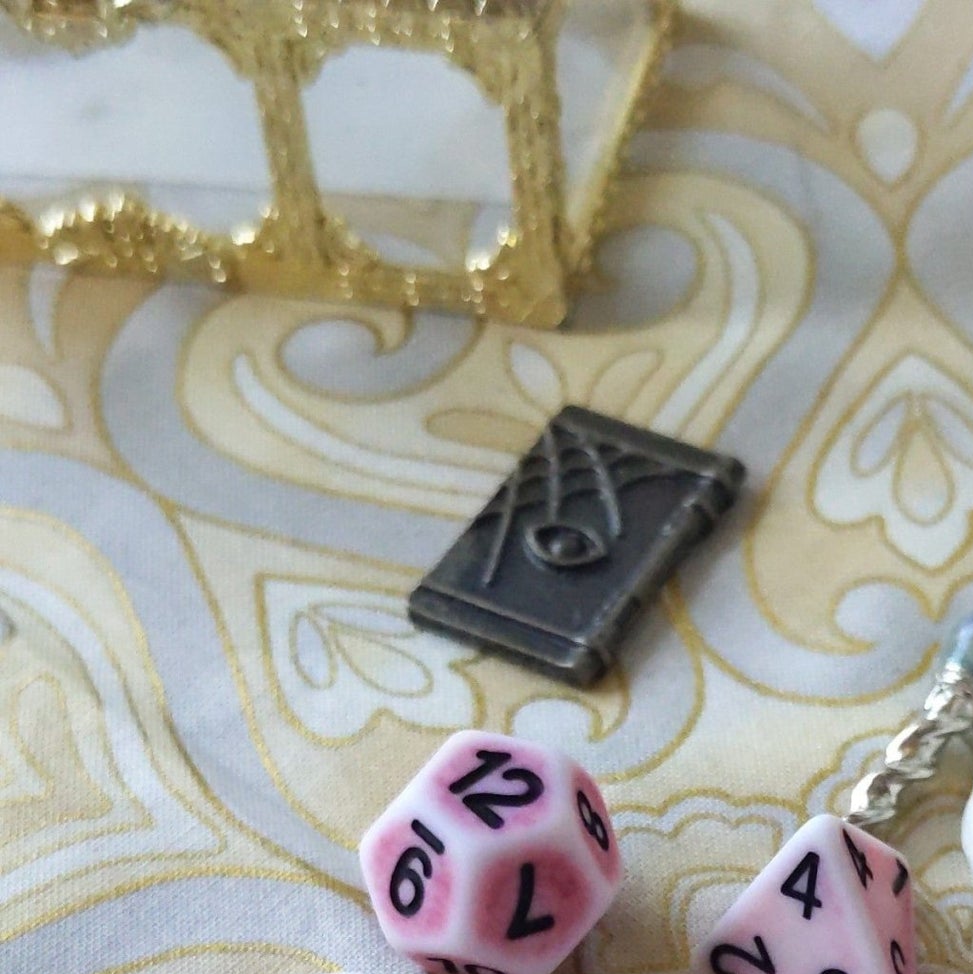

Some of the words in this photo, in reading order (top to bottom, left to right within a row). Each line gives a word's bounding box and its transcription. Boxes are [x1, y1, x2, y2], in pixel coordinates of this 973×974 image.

[448, 749, 545, 830] 12
[576, 789, 610, 851] 8
[780, 851, 823, 920] 4
